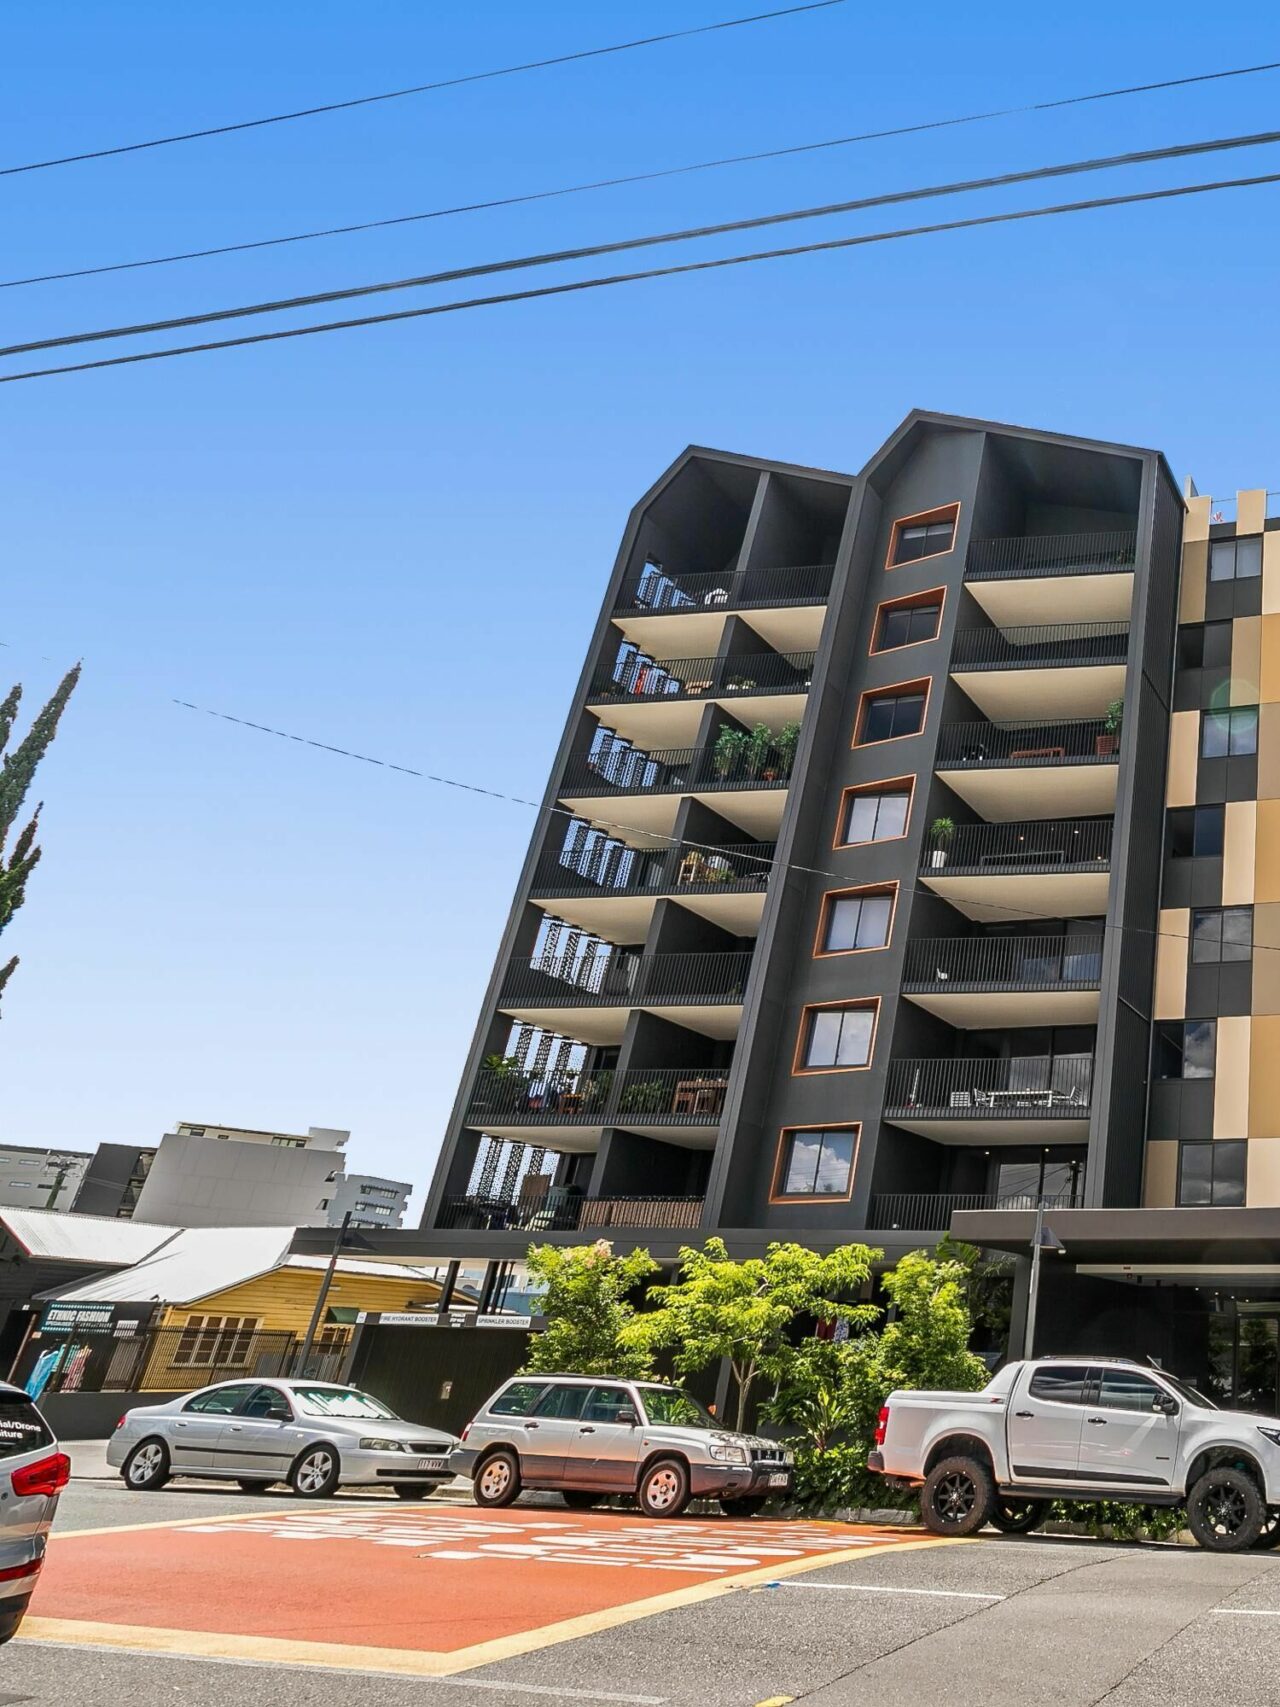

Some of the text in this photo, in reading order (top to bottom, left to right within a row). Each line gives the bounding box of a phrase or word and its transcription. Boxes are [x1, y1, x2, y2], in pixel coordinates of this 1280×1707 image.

[46, 1309, 112, 1322] ETHNIC FASHION
[0, 1419, 42, 1432] ial/Drone
